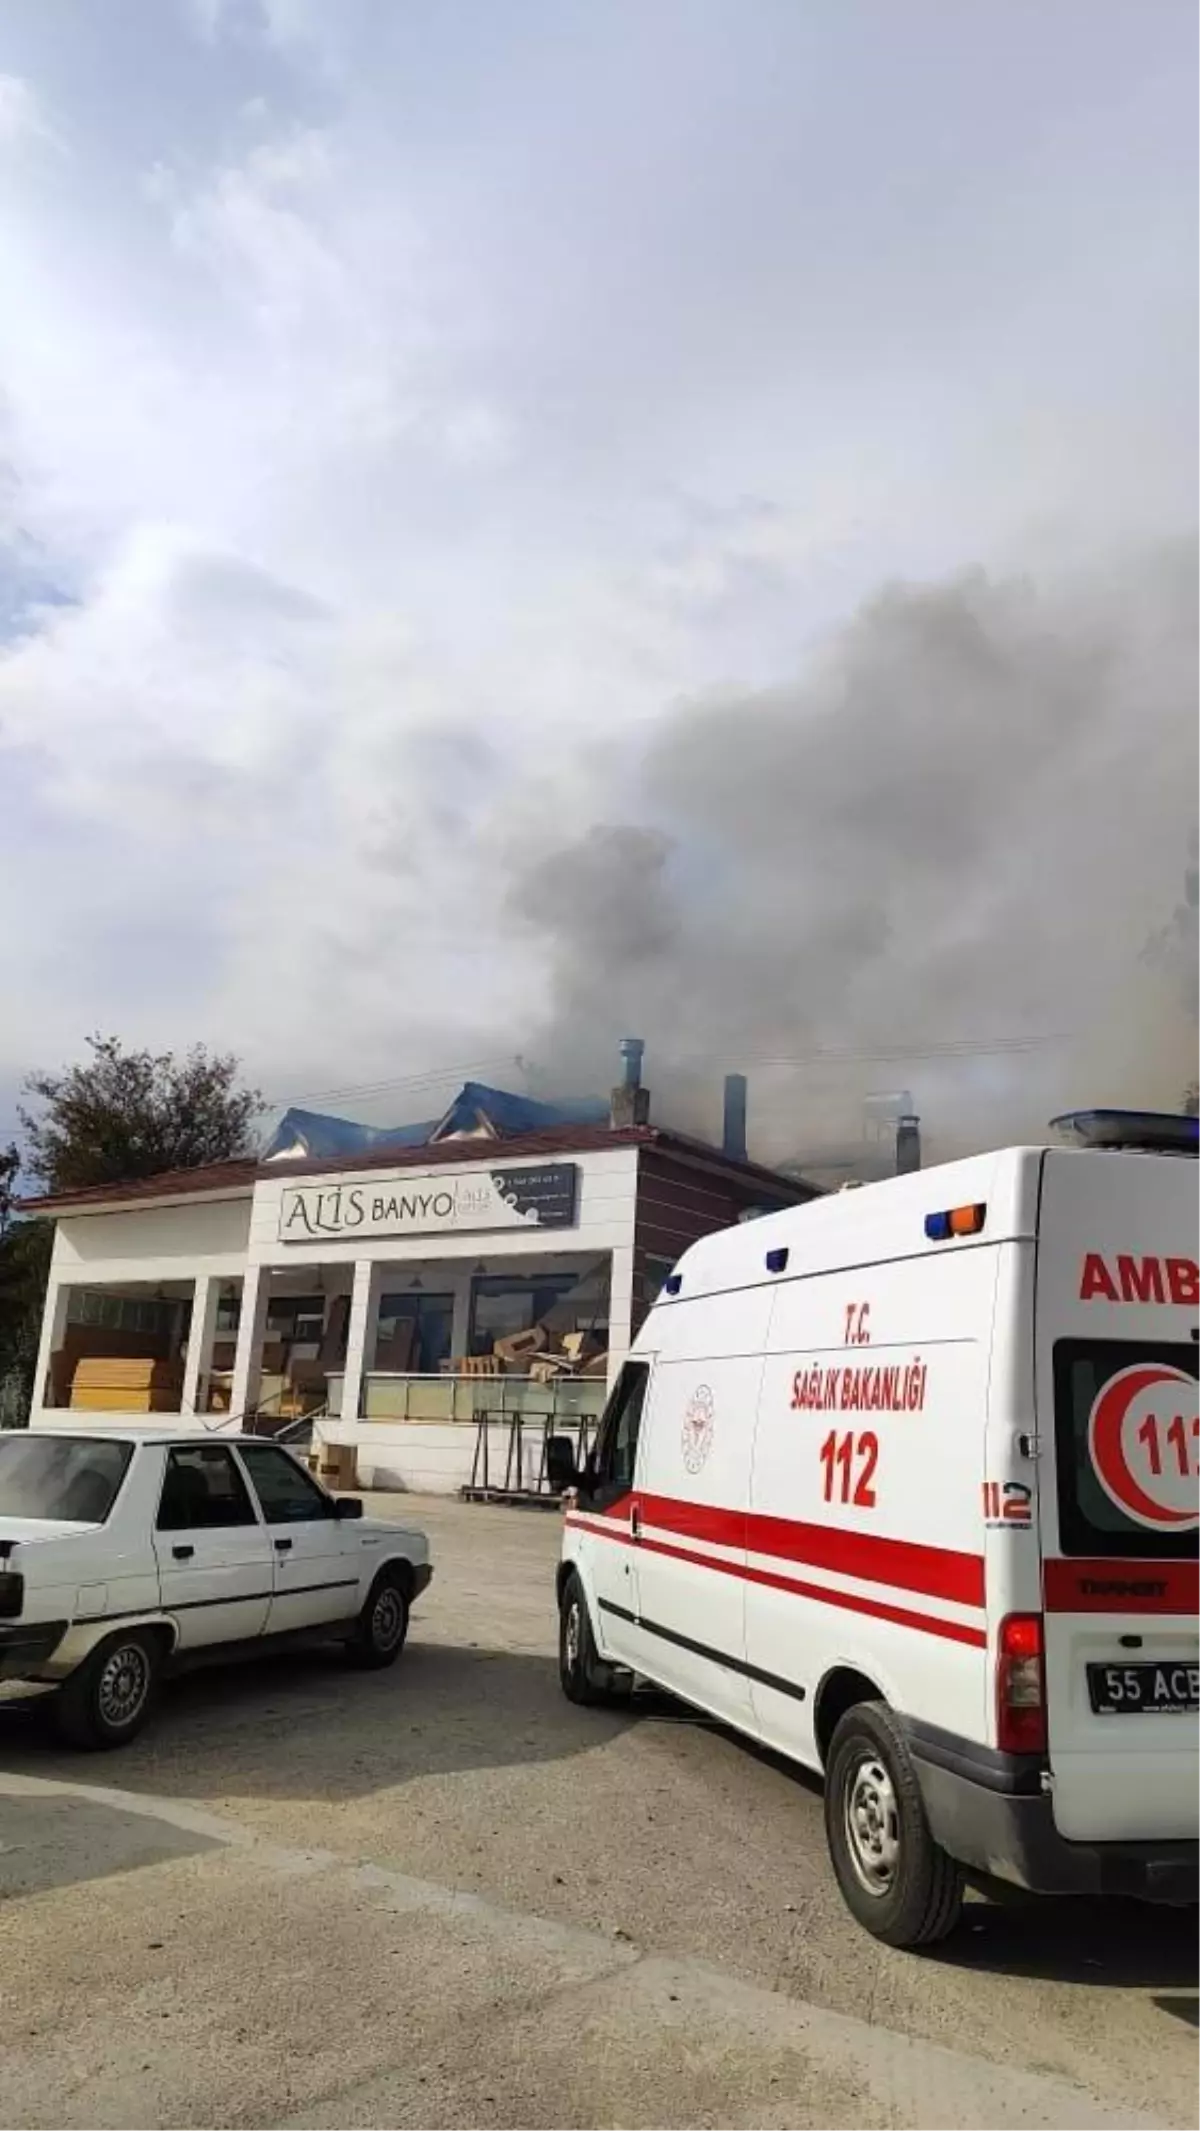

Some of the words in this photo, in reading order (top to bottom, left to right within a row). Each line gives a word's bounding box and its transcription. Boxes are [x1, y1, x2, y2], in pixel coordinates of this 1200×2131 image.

[371, 1192, 453, 1221] BANYO
[1079, 1253, 1200, 1306] AMB
[844, 1303, 871, 1344] T.C.
[790, 1361, 842, 1411] SAĞLIK
[840, 1356, 928, 1412] BAKANLIĞI
[819, 1429, 880, 1508] 112
[981, 1482, 1032, 1519] 112
[1106, 1670, 1141, 1700] 55
